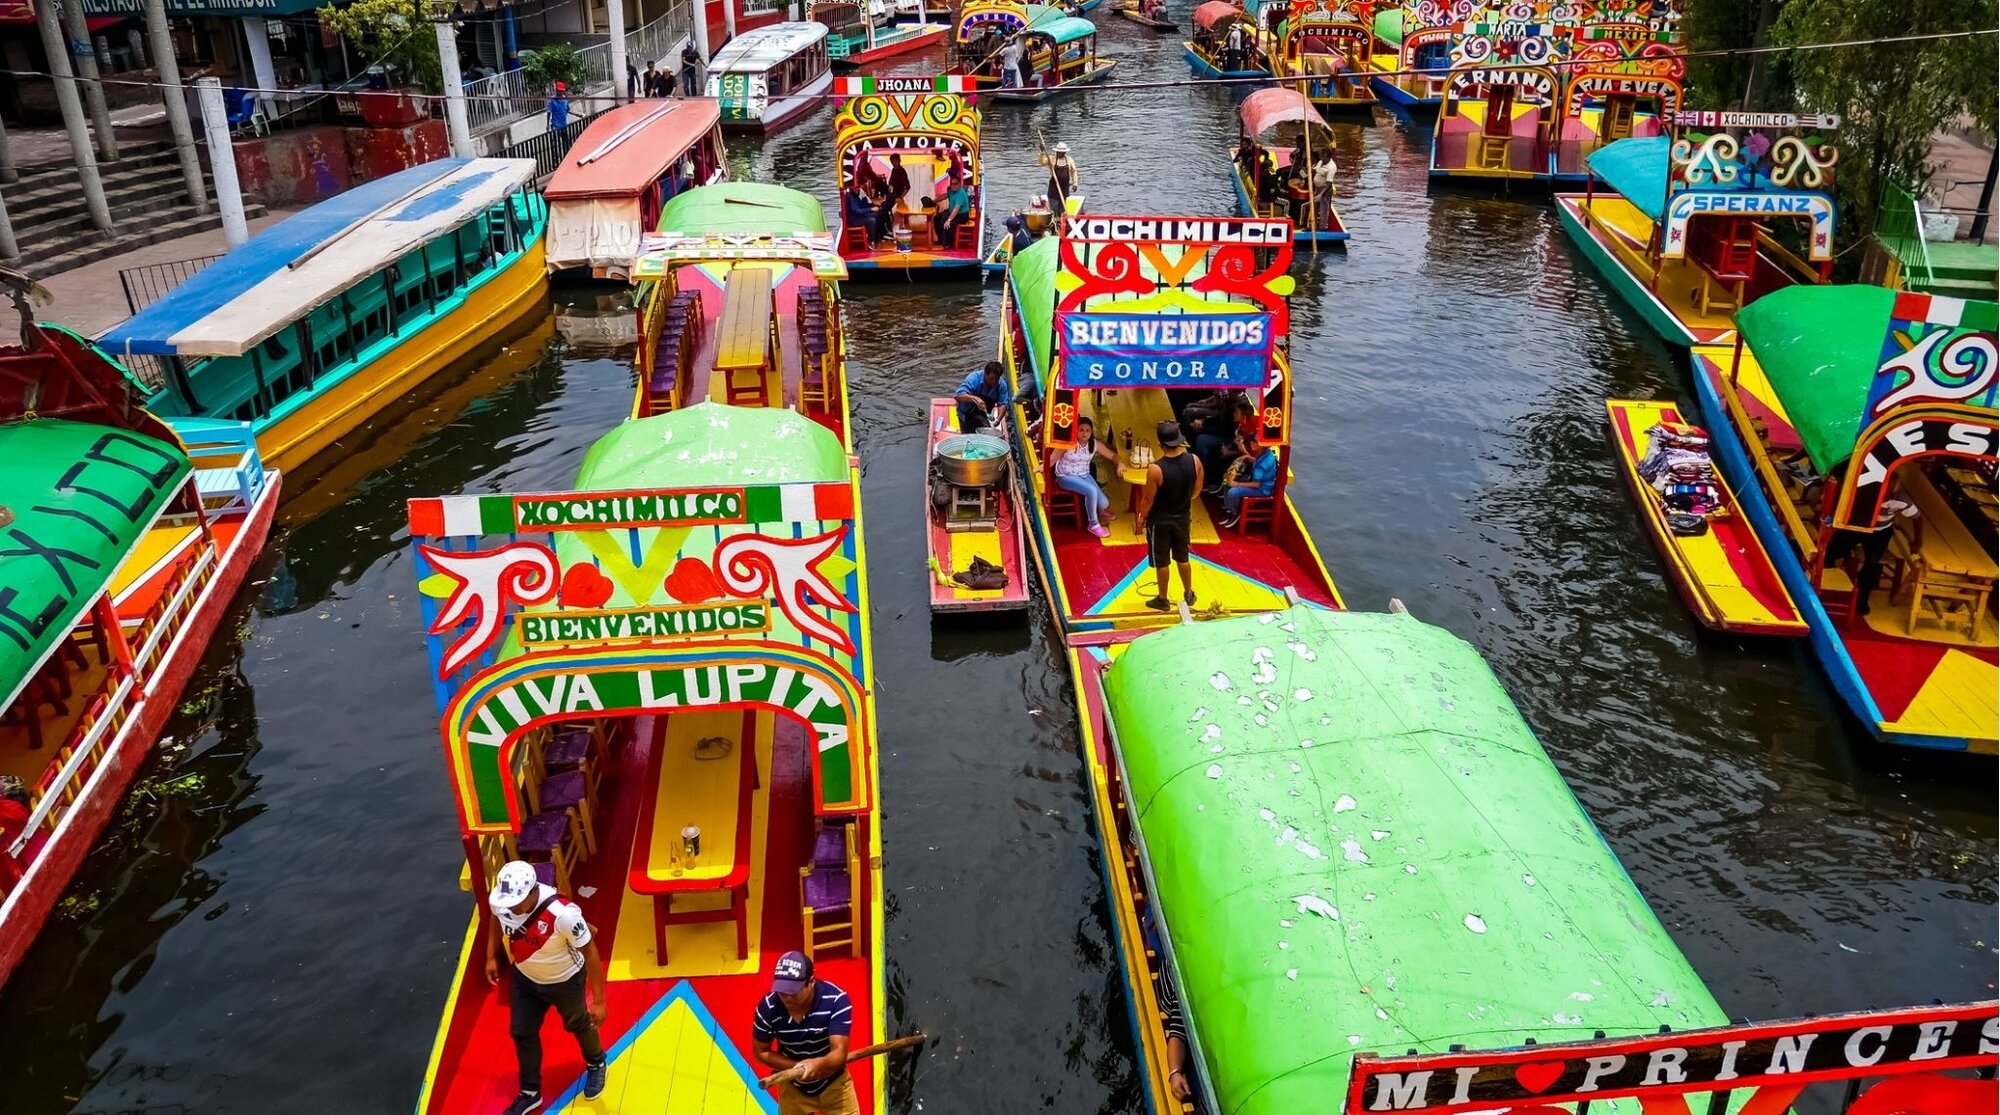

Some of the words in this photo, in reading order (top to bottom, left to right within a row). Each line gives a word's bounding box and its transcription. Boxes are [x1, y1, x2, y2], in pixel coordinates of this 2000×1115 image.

[1290, 28, 1369, 46] XOCHIMILCO
[1604, 30, 1656, 41] MEXICO
[877, 79, 931, 91] JHOANA
[1448, 69, 1553, 109] FERNANDA
[1570, 79, 1613, 116] MARIA
[842, 140, 873, 183] VIVA
[886, 136, 974, 180] VIOLETA
[1673, 196, 1829, 225] ESPERANZA
[1066, 218, 1289, 243] XOCHIMILCO
[1071, 319, 1264, 347] BIENVENIDOS
[1089, 361, 1230, 381] SONORA
[519, 491, 741, 525] XOCHIMILCO
[522, 604, 767, 642] BIENVENIDOS
[467, 673, 604, 749] VIVA
[638, 664, 849, 754] LUPITA
[1369, 1066, 1481, 1112] MI
